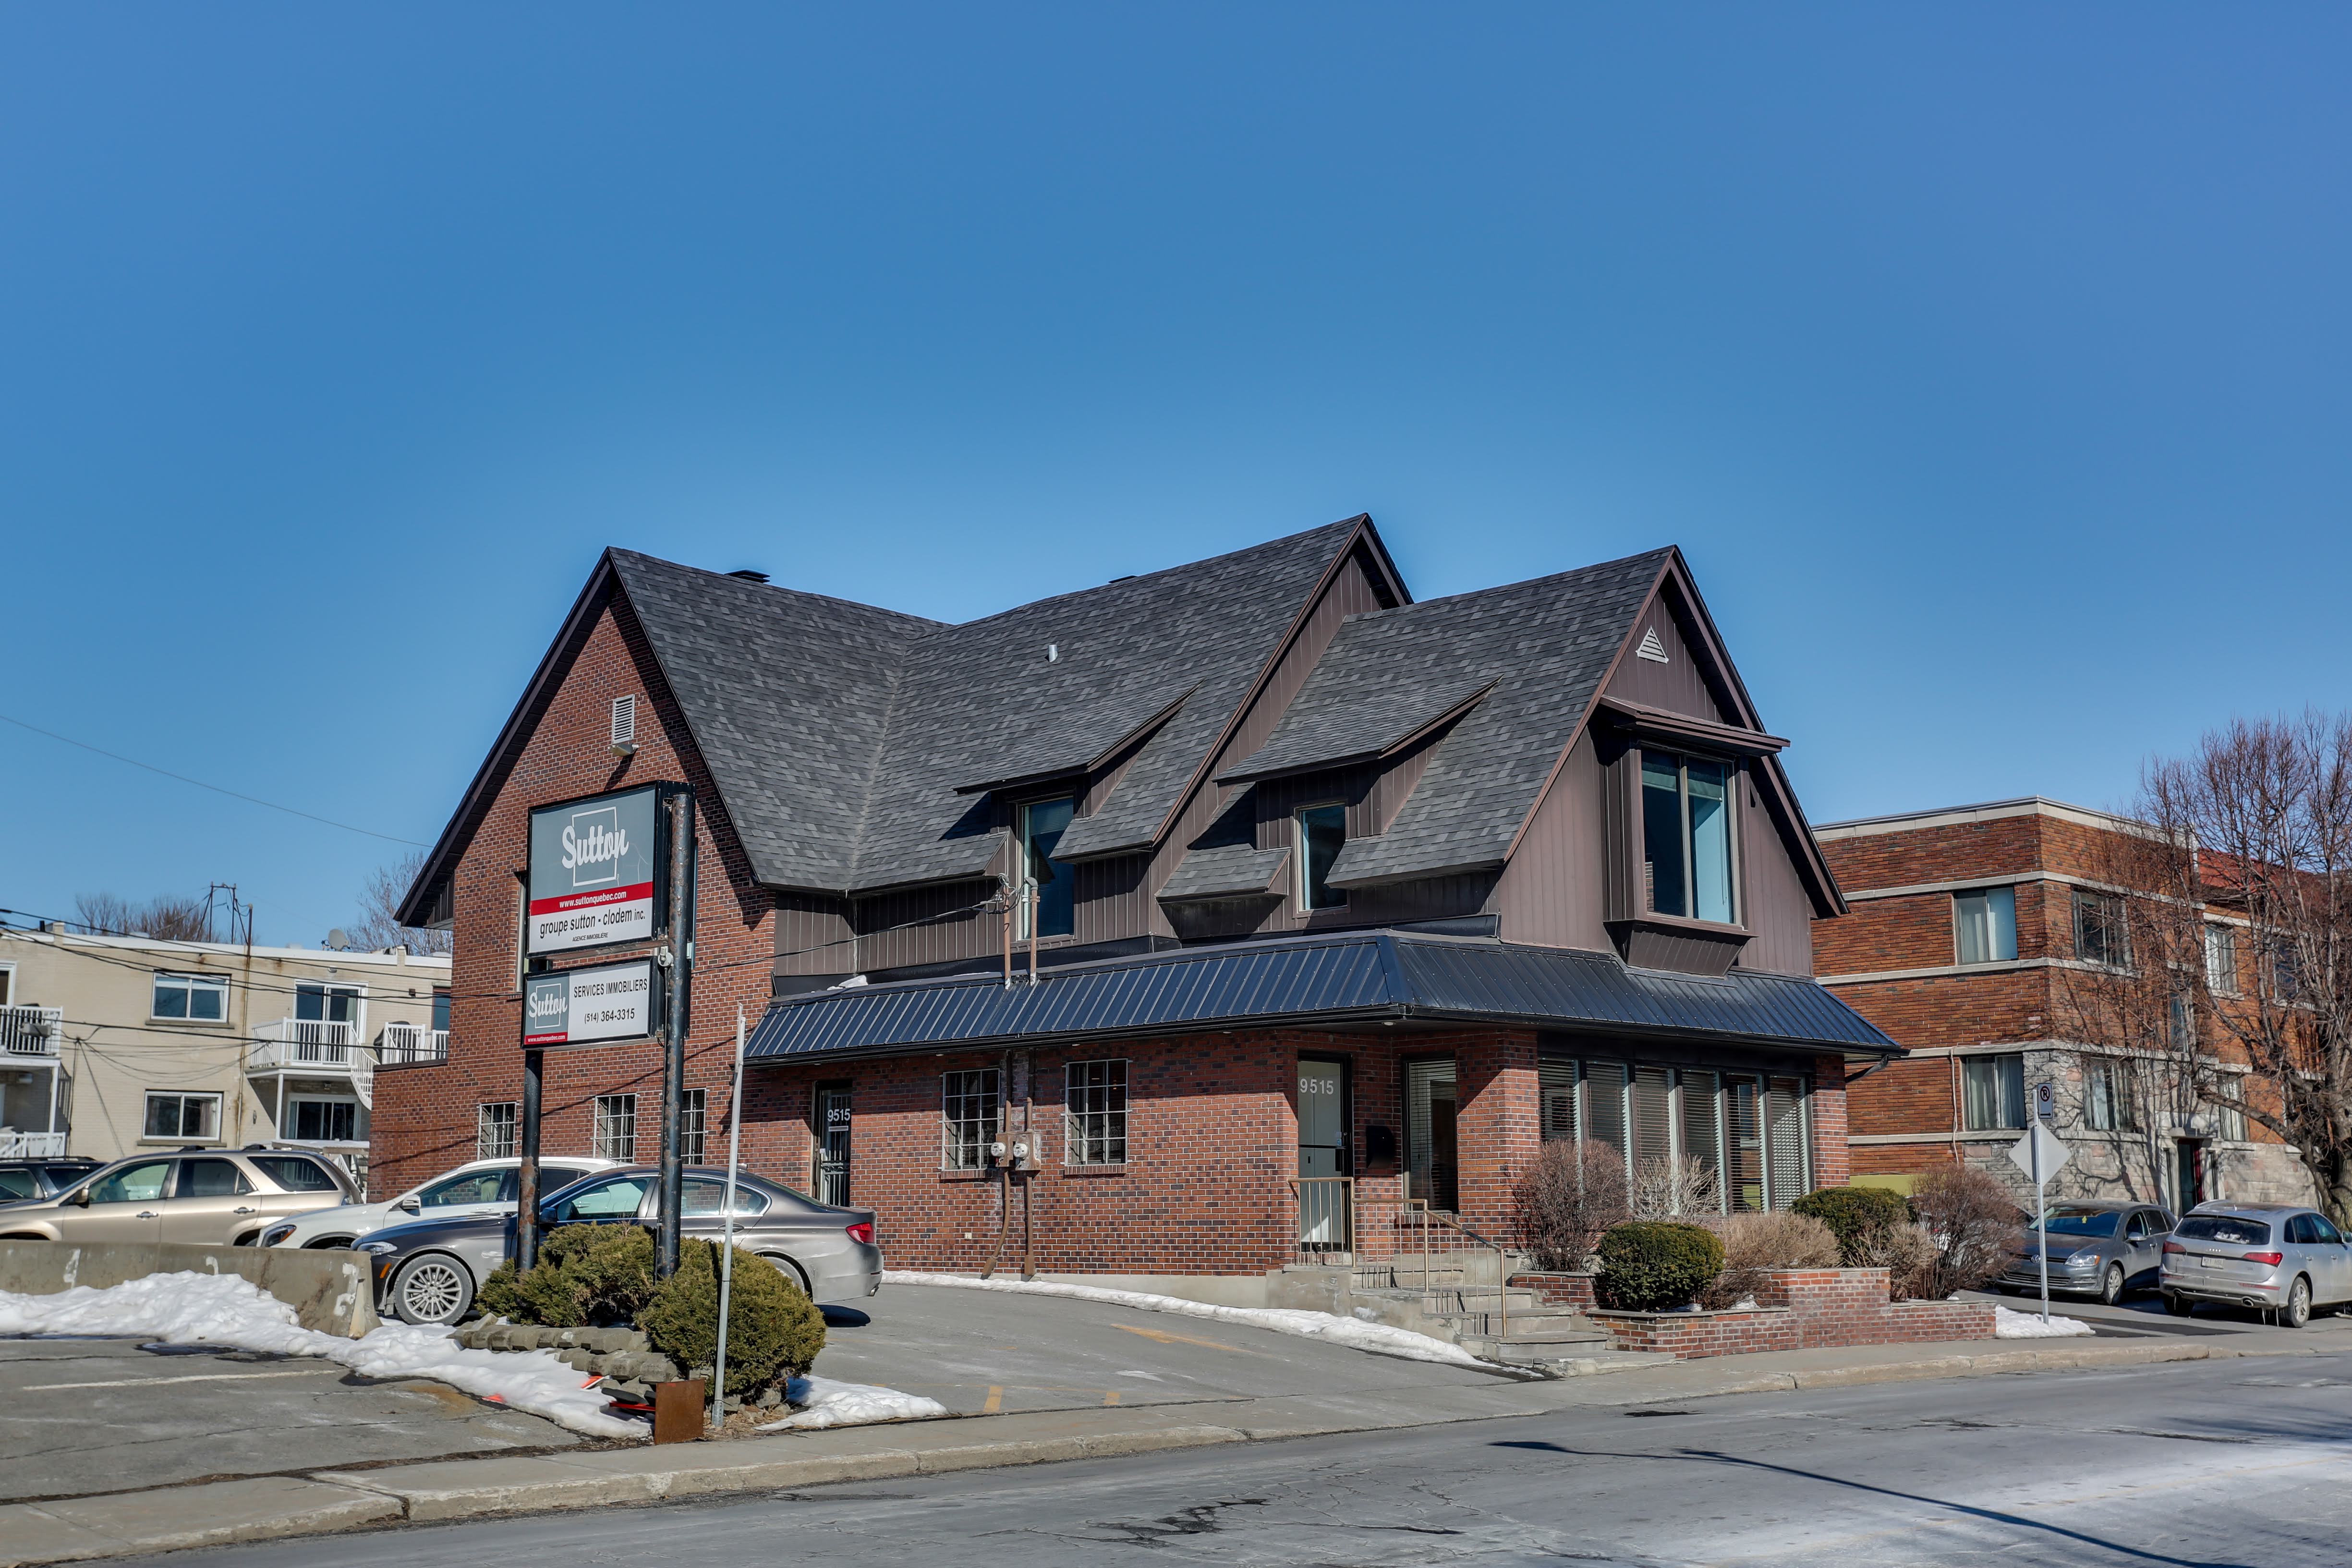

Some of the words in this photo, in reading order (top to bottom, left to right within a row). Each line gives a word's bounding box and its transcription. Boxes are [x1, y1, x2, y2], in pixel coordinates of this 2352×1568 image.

[561, 825, 630, 869] Sutton
[559, 891, 627, 909] www.suttonquebec.com
[540, 919, 568, 939] groupe
[570, 914, 595, 931] sutton
[603, 908, 632, 925] clodem
[634, 909, 645, 921] inc.
[586, 932, 608, 940] IMMOBILIÈRE
[574, 983, 604, 998] SERVICES
[606, 978, 648, 995] IMMOBILIERS
[528, 992, 568, 1018] Sutton
[584, 1012, 599, 1024] (514)
[601, 1008, 635, 1022] 364-3315
[1300, 1078, 1334, 1095] 9515
[827, 1108, 850, 1122] 9515
